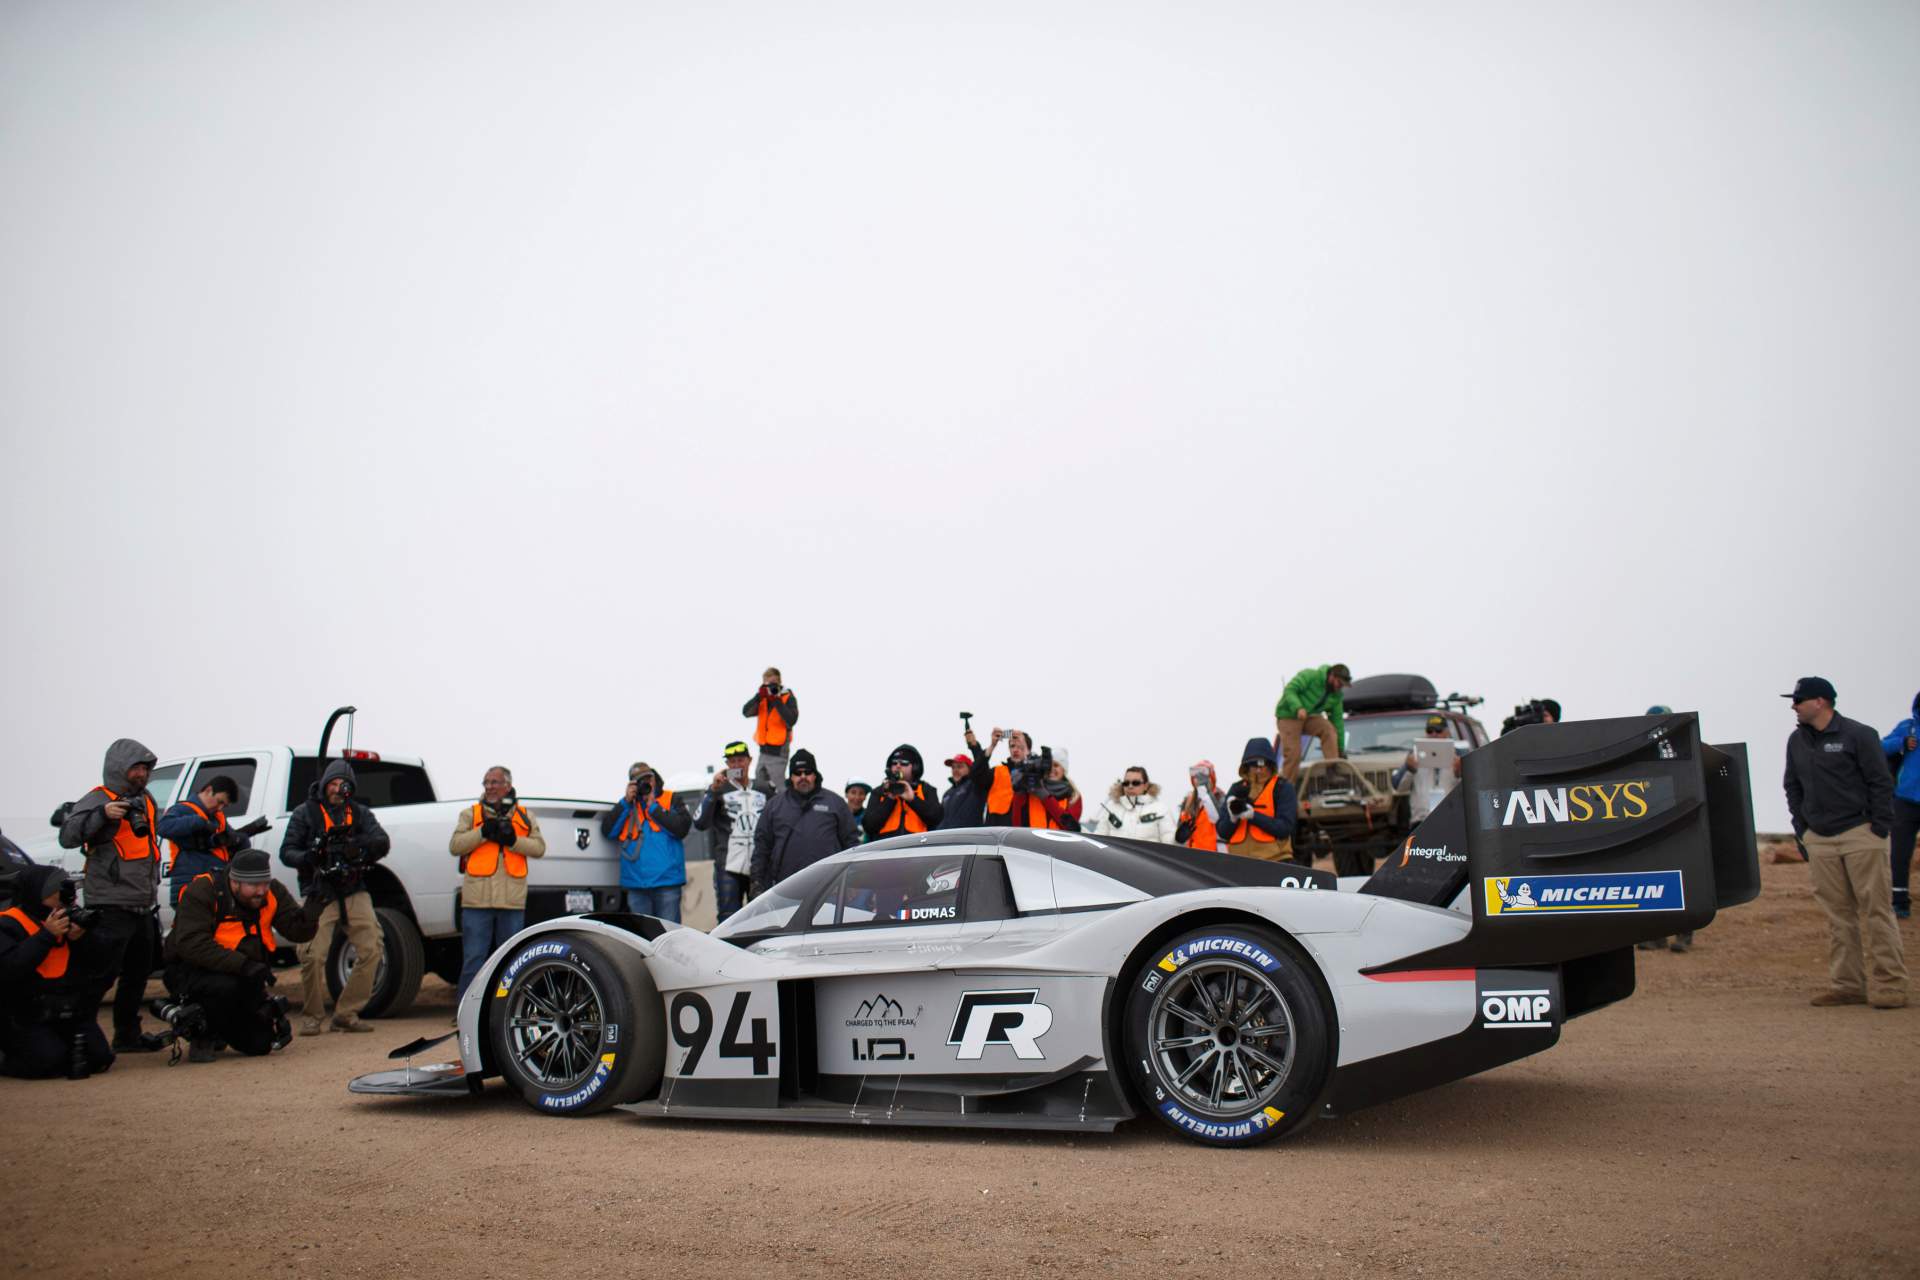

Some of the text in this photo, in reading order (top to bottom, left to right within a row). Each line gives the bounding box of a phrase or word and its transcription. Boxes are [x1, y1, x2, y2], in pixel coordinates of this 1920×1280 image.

[1503, 781, 1648, 825] ANSYS
[1437, 853, 1467, 862] e-drive
[1541, 885, 1664, 902] MICHELIN
[911, 907, 956, 920] DUMAS
[509, 943, 563, 973] MICHELIN
[1189, 939, 1273, 967] MICHELIN
[846, 1019, 873, 1027] CHARGED
[874, 1019, 883, 1027] TO
[897, 1018, 914, 1026] PEAK
[1482, 996, 1551, 1021] OMP
[671, 991, 776, 1075] 94
[950, 994, 1053, 1060] R
[852, 1037, 915, 1060] I.D.
[544, 1077, 601, 1107] MICHELIN
[1167, 1106, 1250, 1137] MICHELIN
